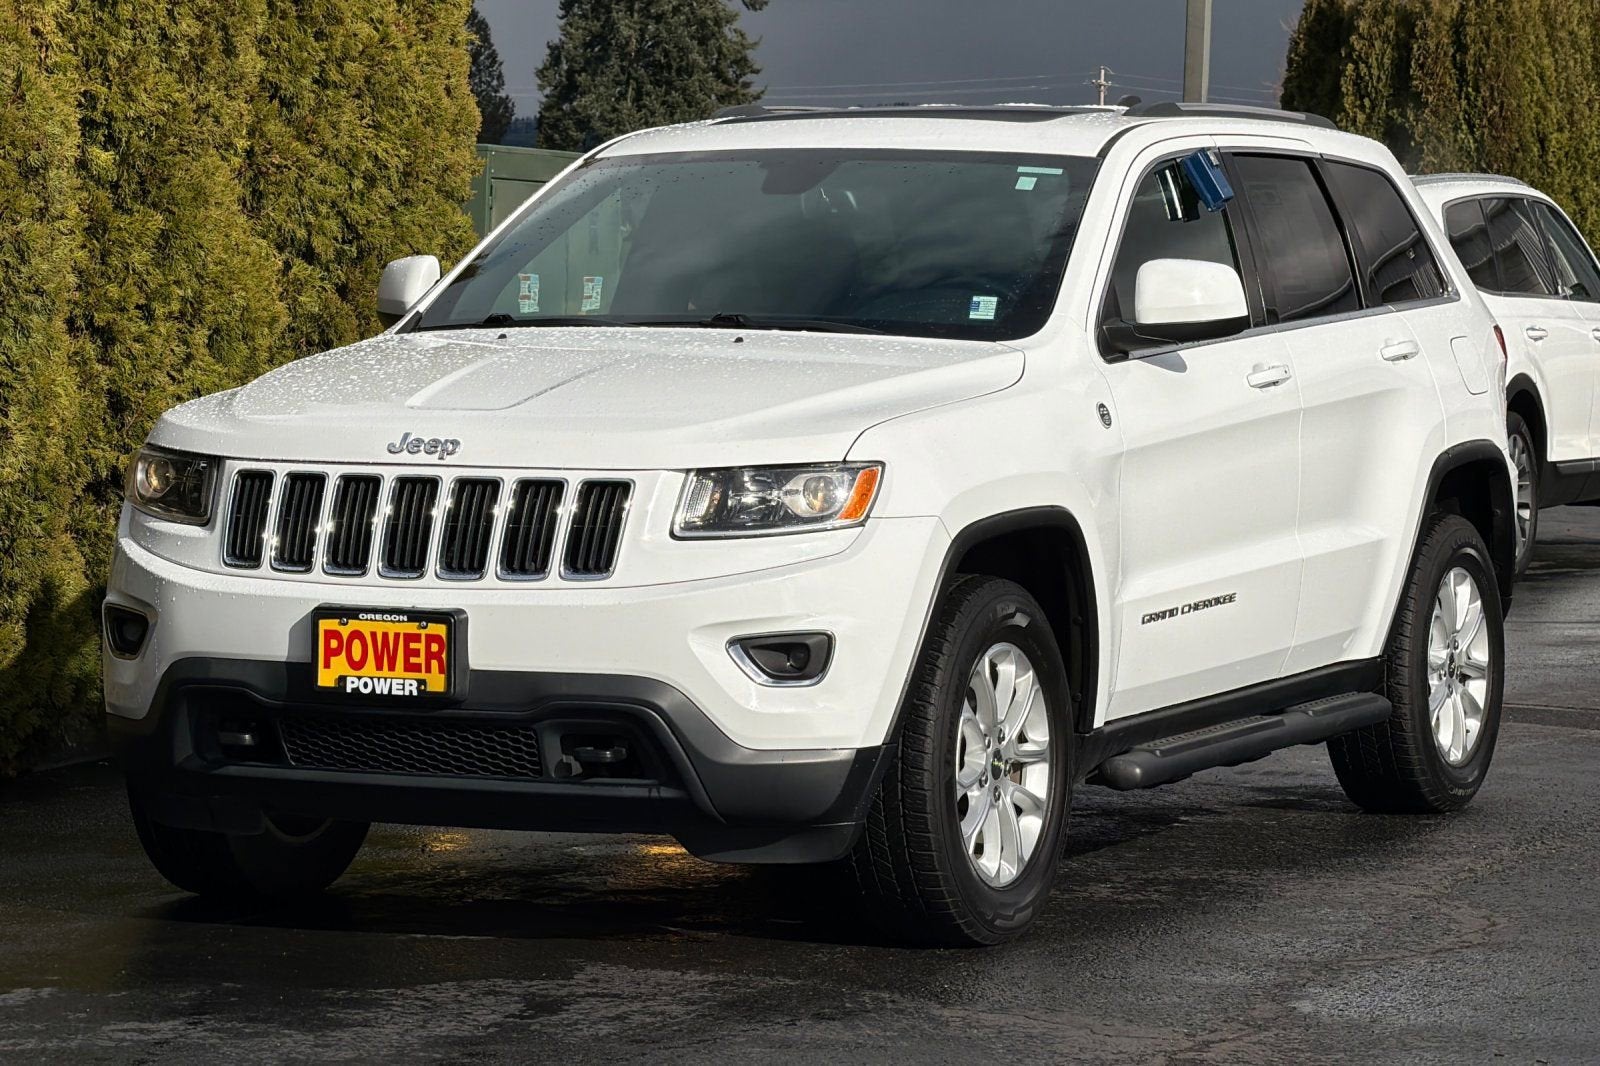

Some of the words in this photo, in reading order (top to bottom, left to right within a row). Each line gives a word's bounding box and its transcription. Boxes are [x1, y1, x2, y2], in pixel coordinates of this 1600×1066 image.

[386, 431, 461, 460] Jeep
[358, 613, 408, 622] OREGON
[1141, 606, 1179, 625] GRAND
[1180, 592, 1237, 615] CHEROKEE
[323, 629, 446, 675] POWER
[346, 676, 418, 696] POWER
